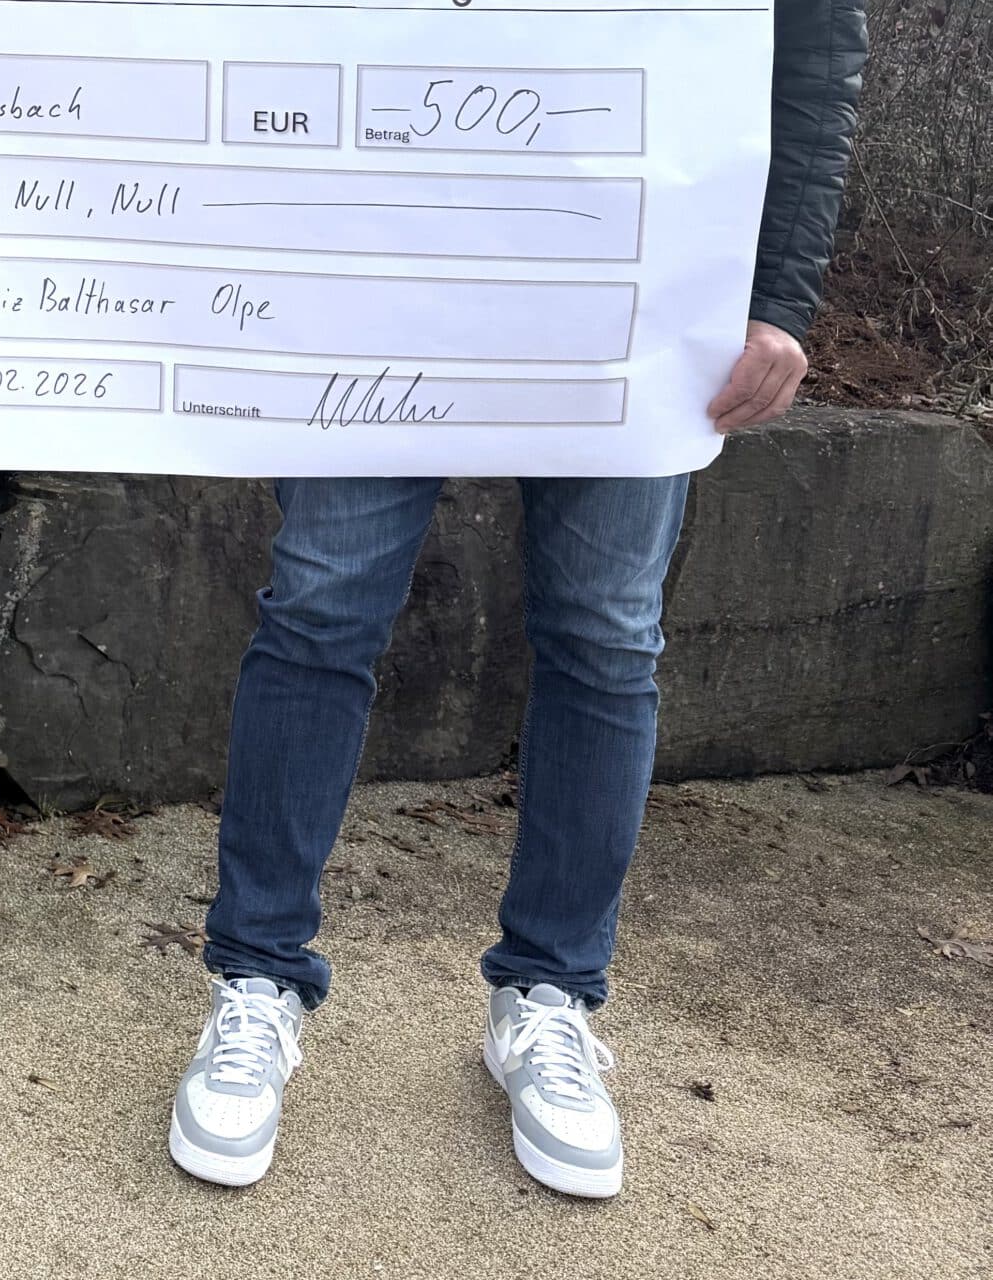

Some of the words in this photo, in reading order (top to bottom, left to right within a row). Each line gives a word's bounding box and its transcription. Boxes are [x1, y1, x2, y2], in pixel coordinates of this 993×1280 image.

[252, 110, 309, 134] EUR
[364, 127, 410, 144] Betrag
[111, 182, 181, 216] Null
[39, 277, 176, 316] Balthasar
[211, 283, 275, 332] Olpe
[181, 401, 262, 419] Unterschrift
